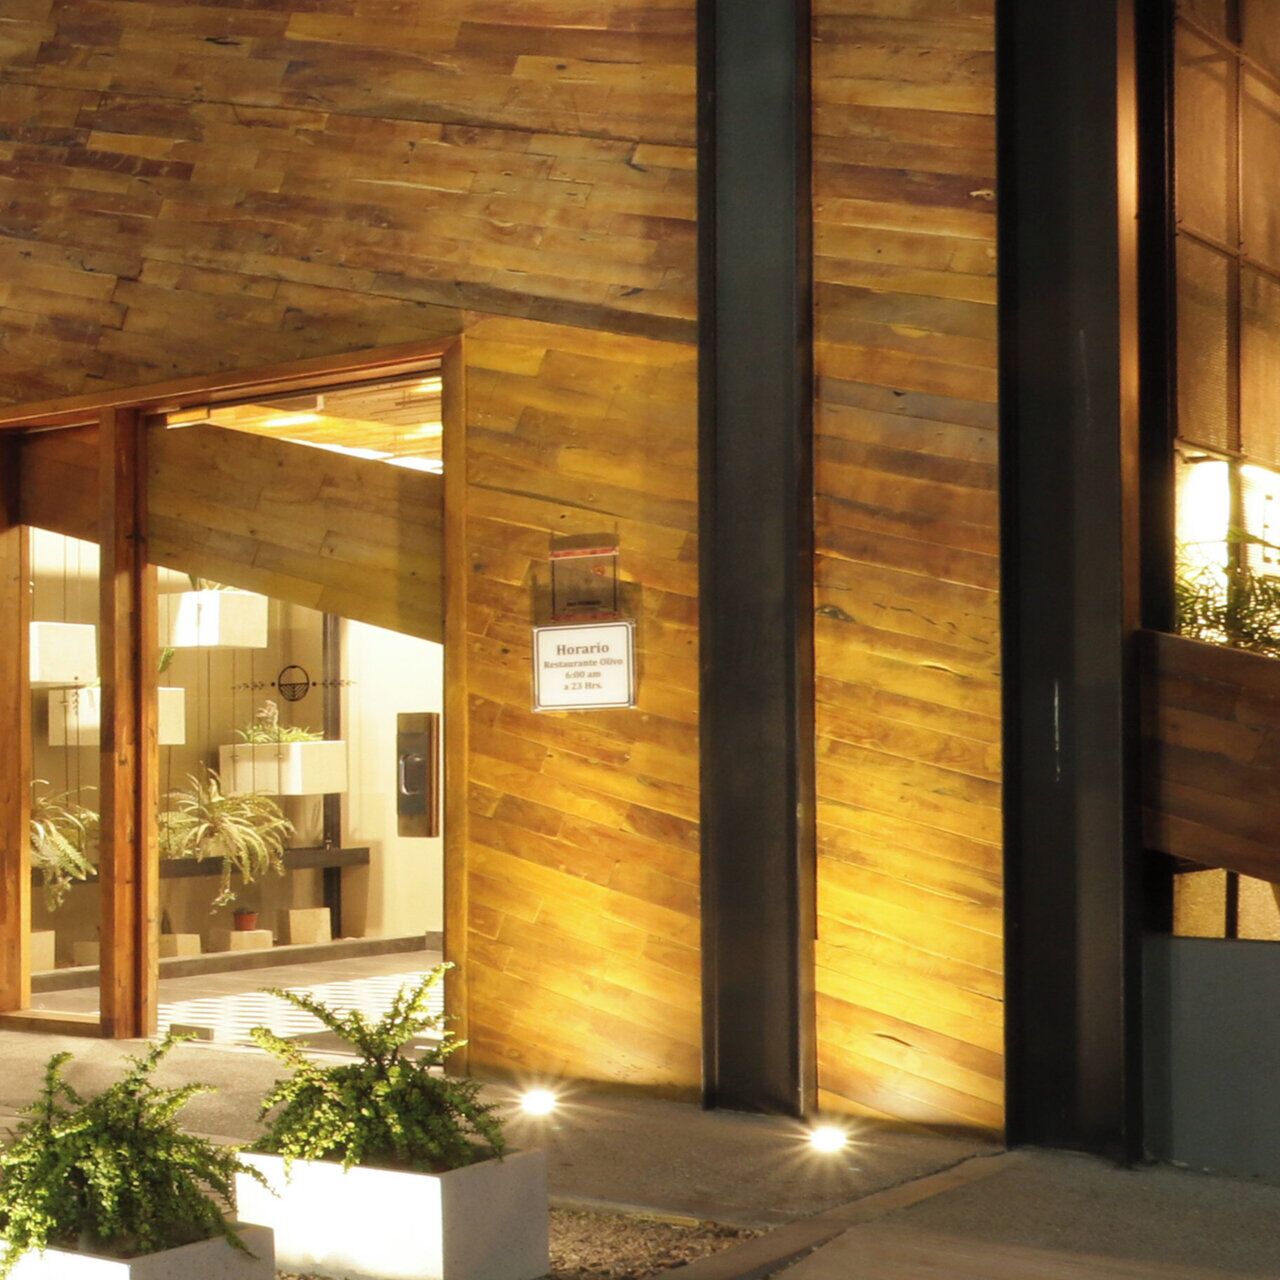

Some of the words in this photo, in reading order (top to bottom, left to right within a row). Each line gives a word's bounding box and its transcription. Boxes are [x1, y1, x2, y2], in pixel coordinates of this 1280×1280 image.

[557, 643, 609, 655] Horario
[543, 659, 598, 669] Restaurante
[599, 658, 624, 666] Olivo
